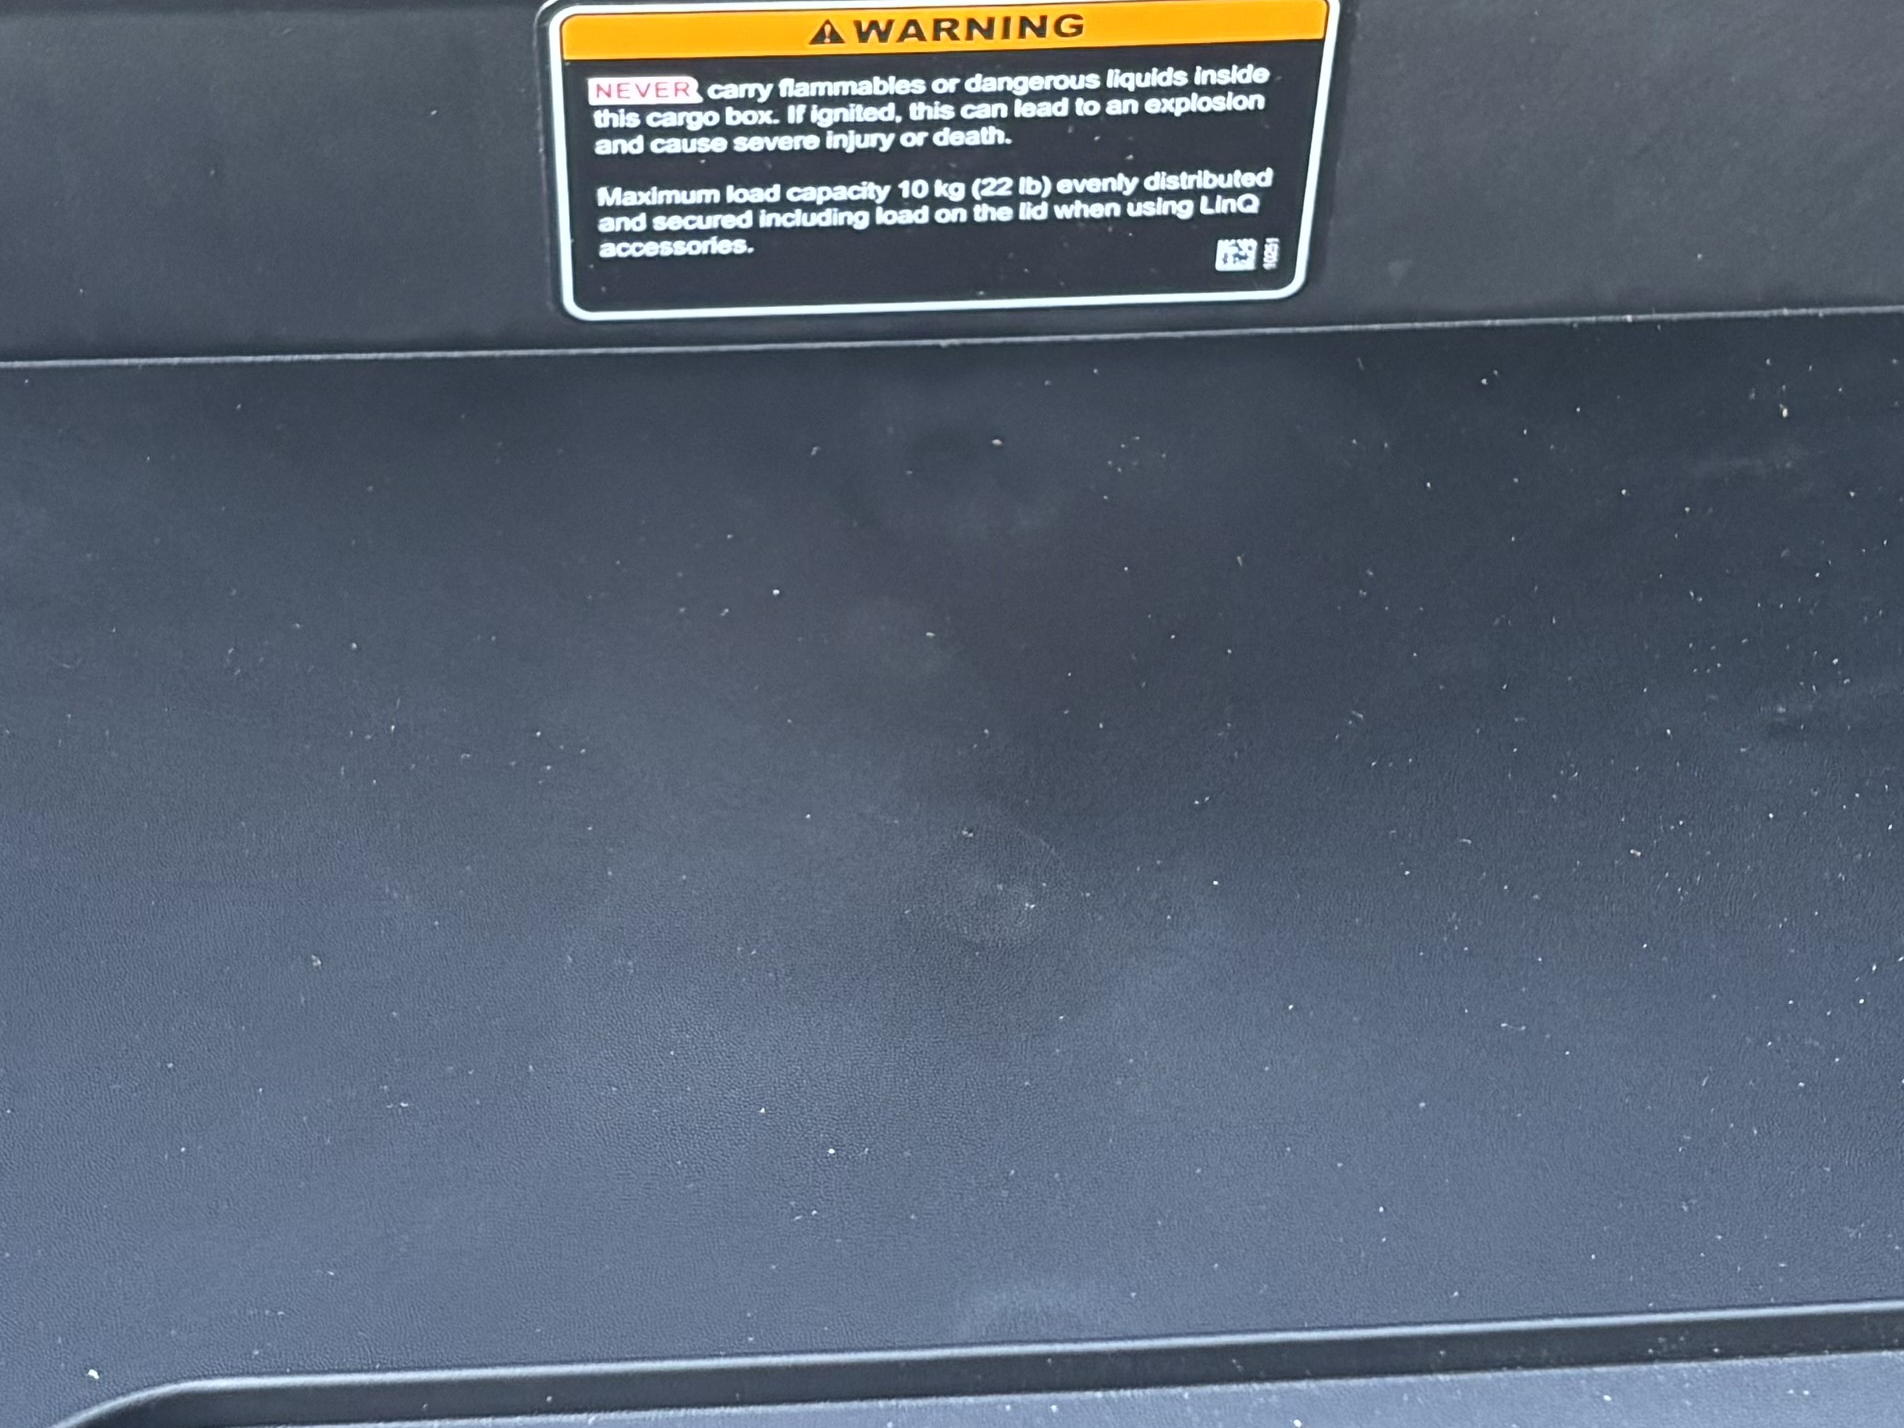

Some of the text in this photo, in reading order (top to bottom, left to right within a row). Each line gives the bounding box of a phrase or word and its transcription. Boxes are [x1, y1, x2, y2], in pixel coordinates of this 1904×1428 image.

[853, 13, 1085, 44] WARNING
[595, 64, 1270, 103] NEVER carry flammables or dangerous liquids inside
[593, 91, 1266, 131] this cargo box. If ignited, this can lead to an explosion
[594, 126, 1012, 155] and cause severe injury or death.
[596, 167, 1274, 206] Maximum load capacity 10 kg (22 lb) evenly distributed
[598, 193, 1260, 233] and secured including load on the lid when using LinQ
[599, 236, 755, 259] accessories.
